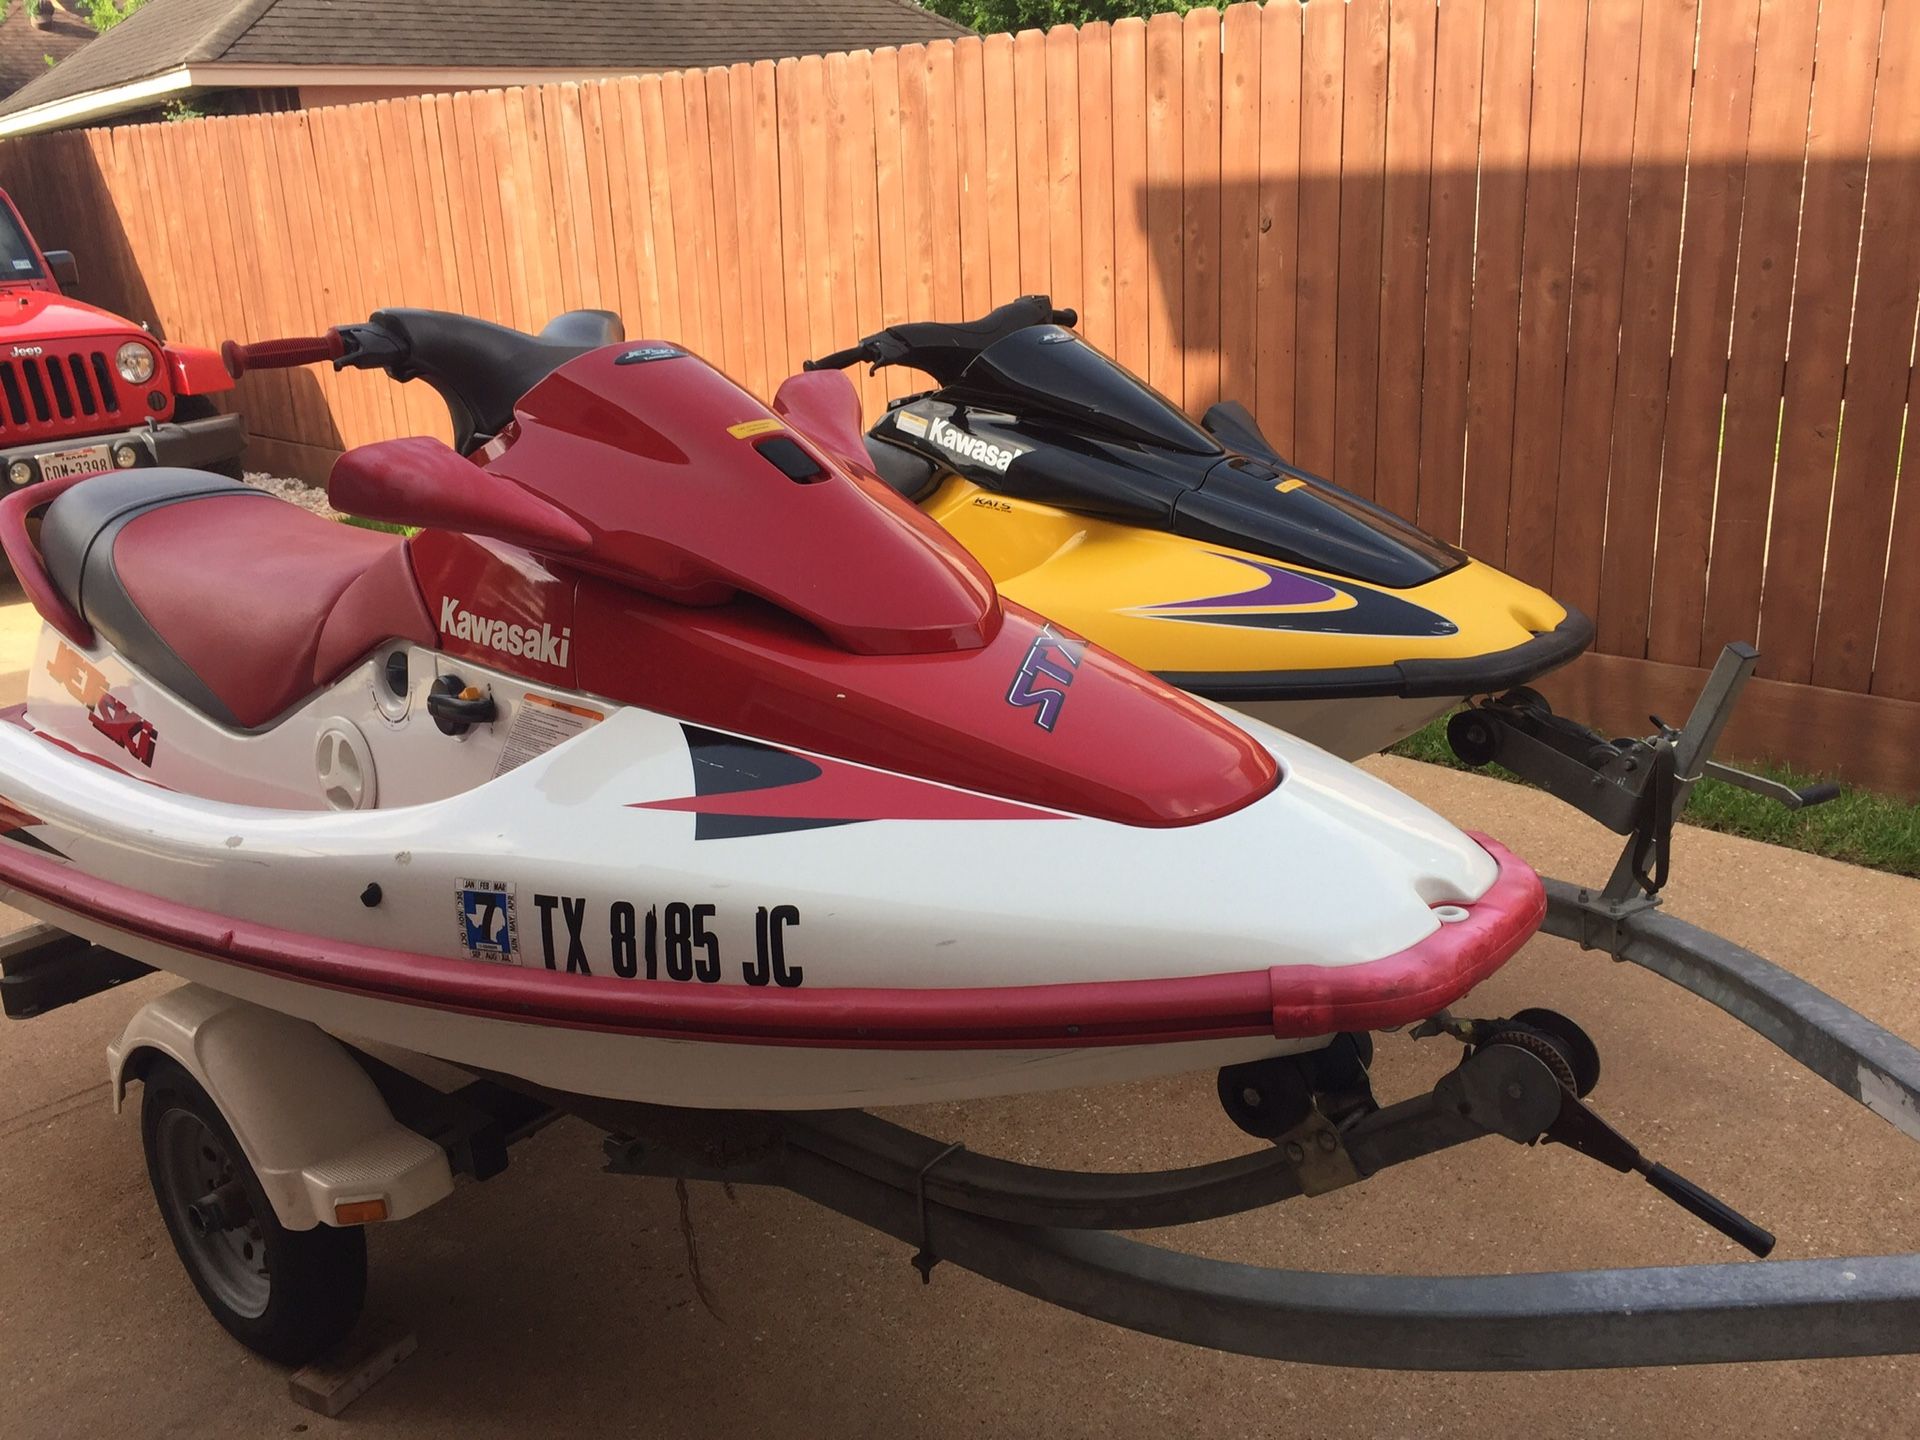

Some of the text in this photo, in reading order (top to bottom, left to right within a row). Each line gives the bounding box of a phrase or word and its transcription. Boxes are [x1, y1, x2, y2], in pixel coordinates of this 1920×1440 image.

[10, 346, 42, 357] Jeep
[929, 417, 1022, 471] Kawasa
[440, 596, 571, 668] Kawasaki
[1005, 621, 1089, 733] STX
[465, 881, 475, 889] JAN
[480, 882, 490, 890] FEB
[473, 891, 498, 943] 7
[534, 894, 804, 988] TX 8185 JC
